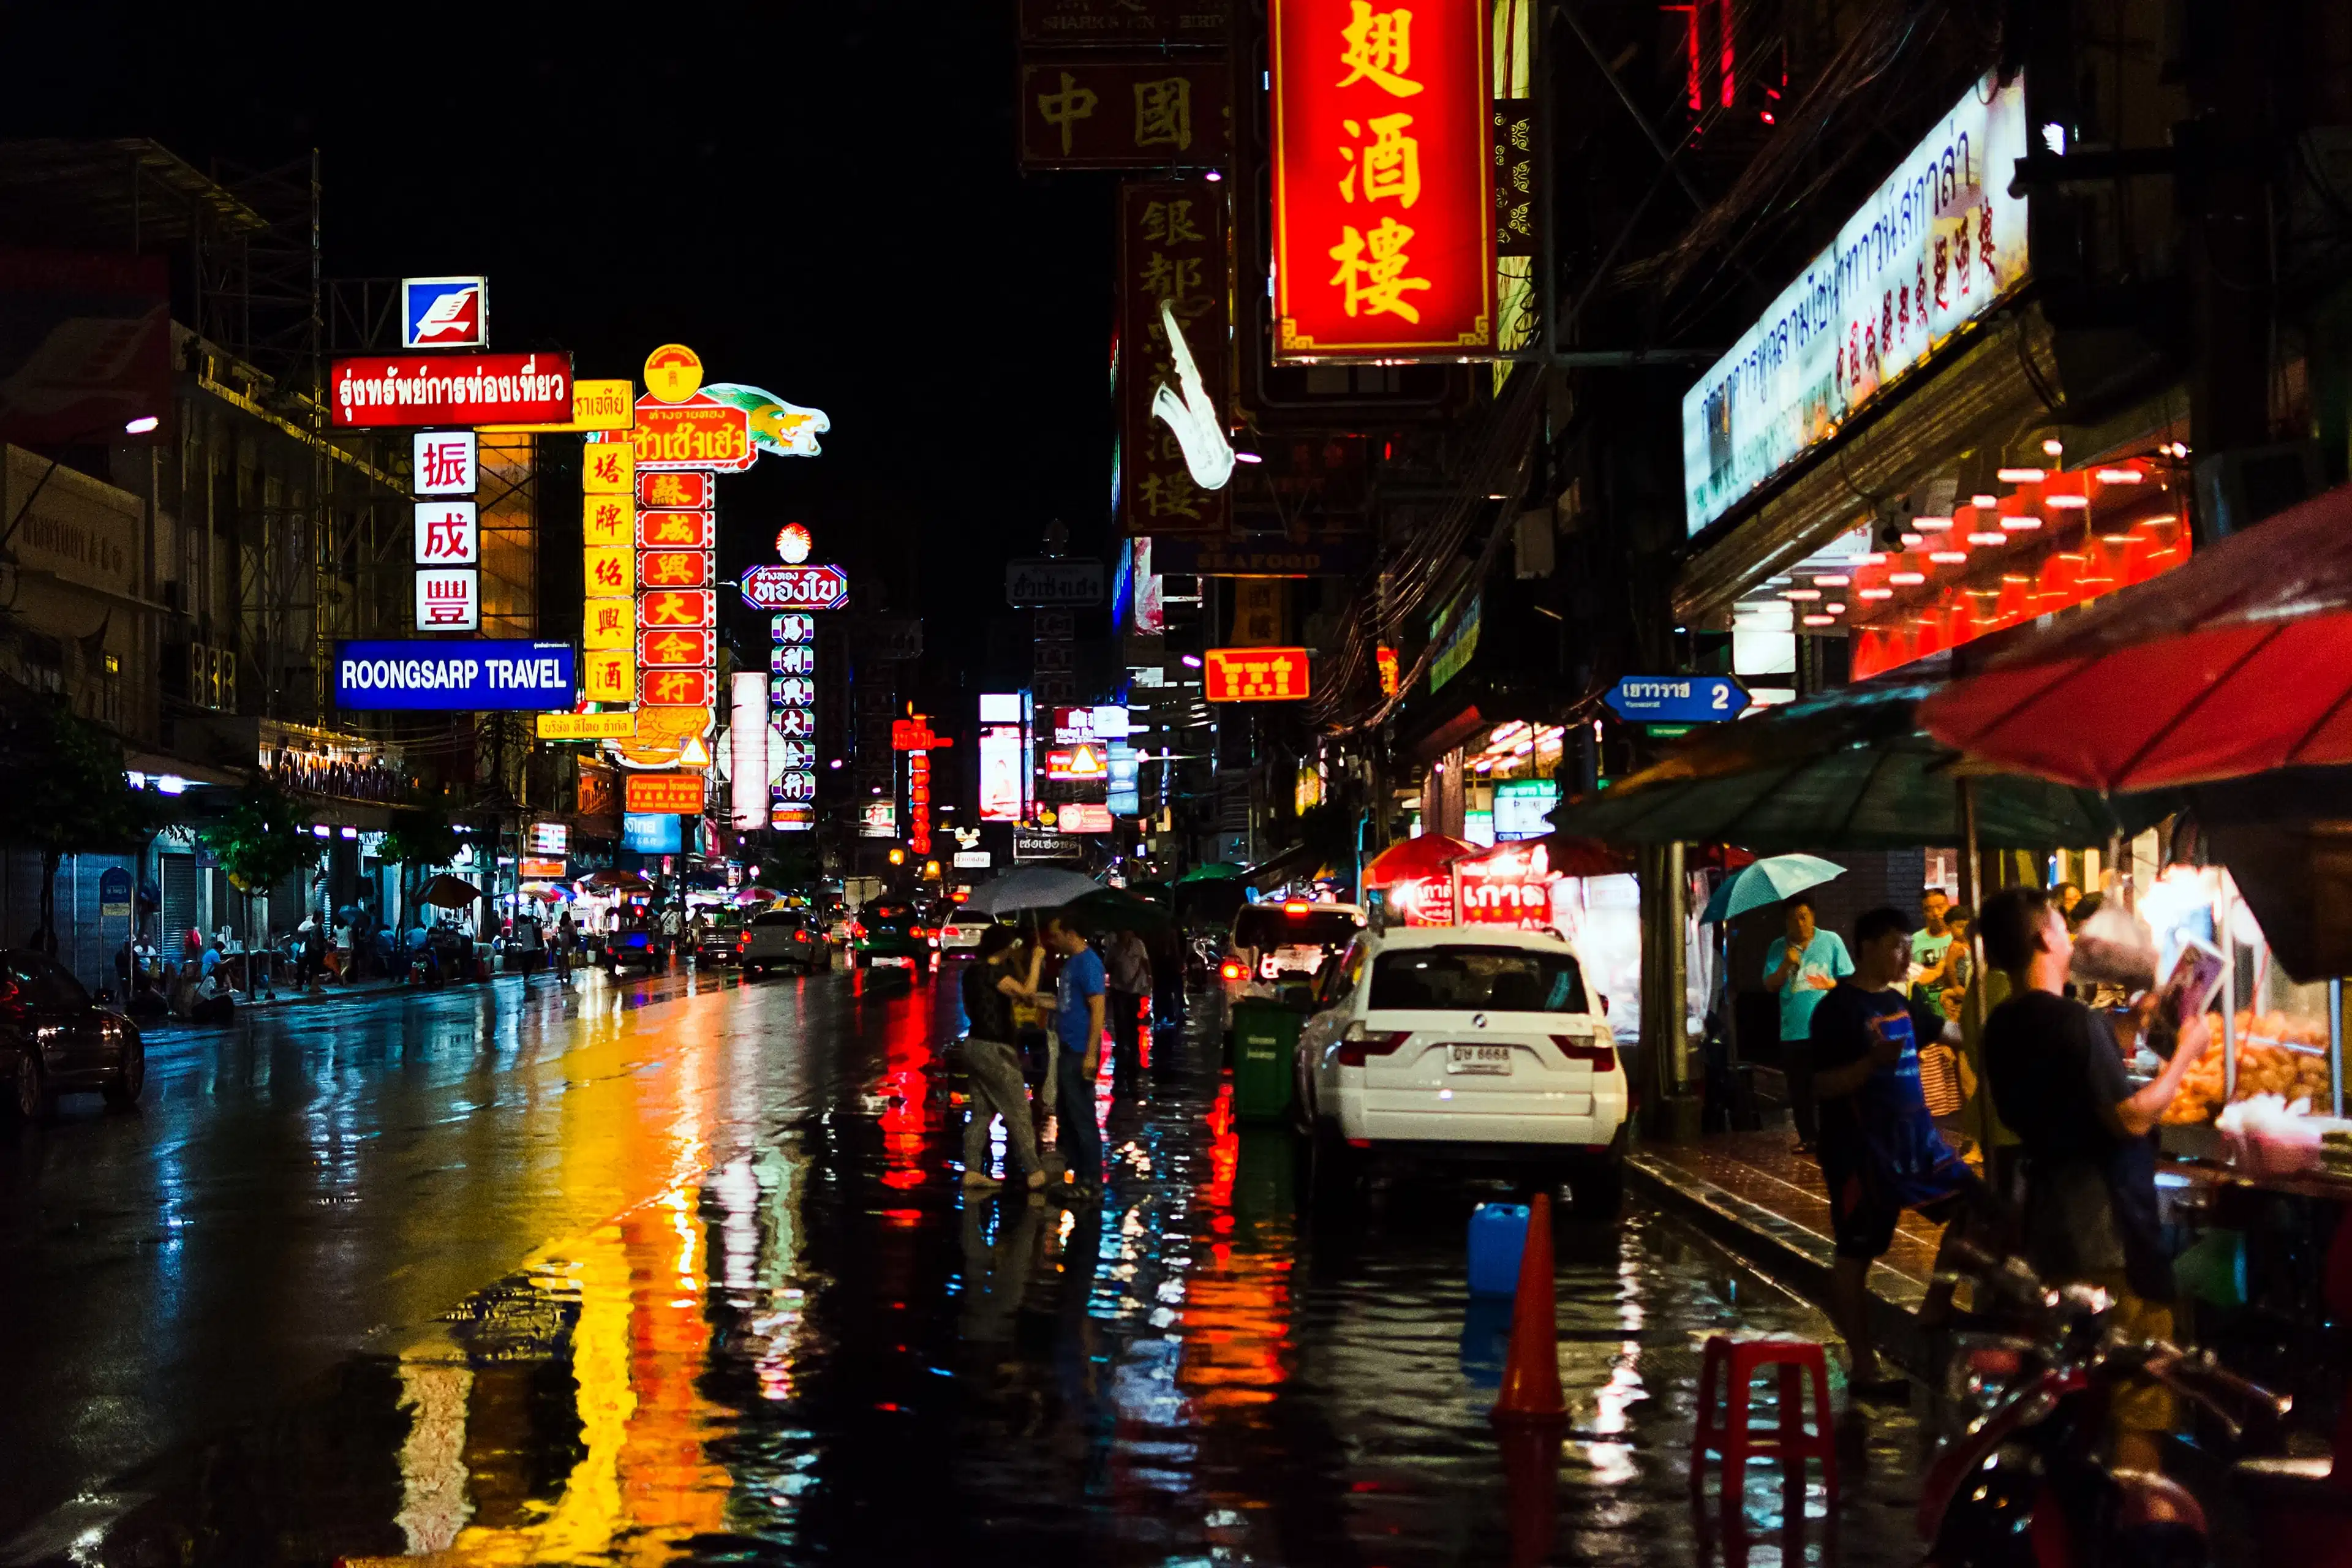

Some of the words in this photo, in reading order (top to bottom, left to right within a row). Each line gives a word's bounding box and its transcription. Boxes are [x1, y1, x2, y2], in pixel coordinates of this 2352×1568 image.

[339, 354, 564, 421] รุ่งทรัพย์การท่องเที่ยว
[423, 442, 470, 625] 振成豐
[342, 660, 478, 689] ROONGSARP
[485, 658, 567, 688] TRAVEL
[1711, 685, 1730, 709] 2
[772, 812, 813, 822] EXCHANG
